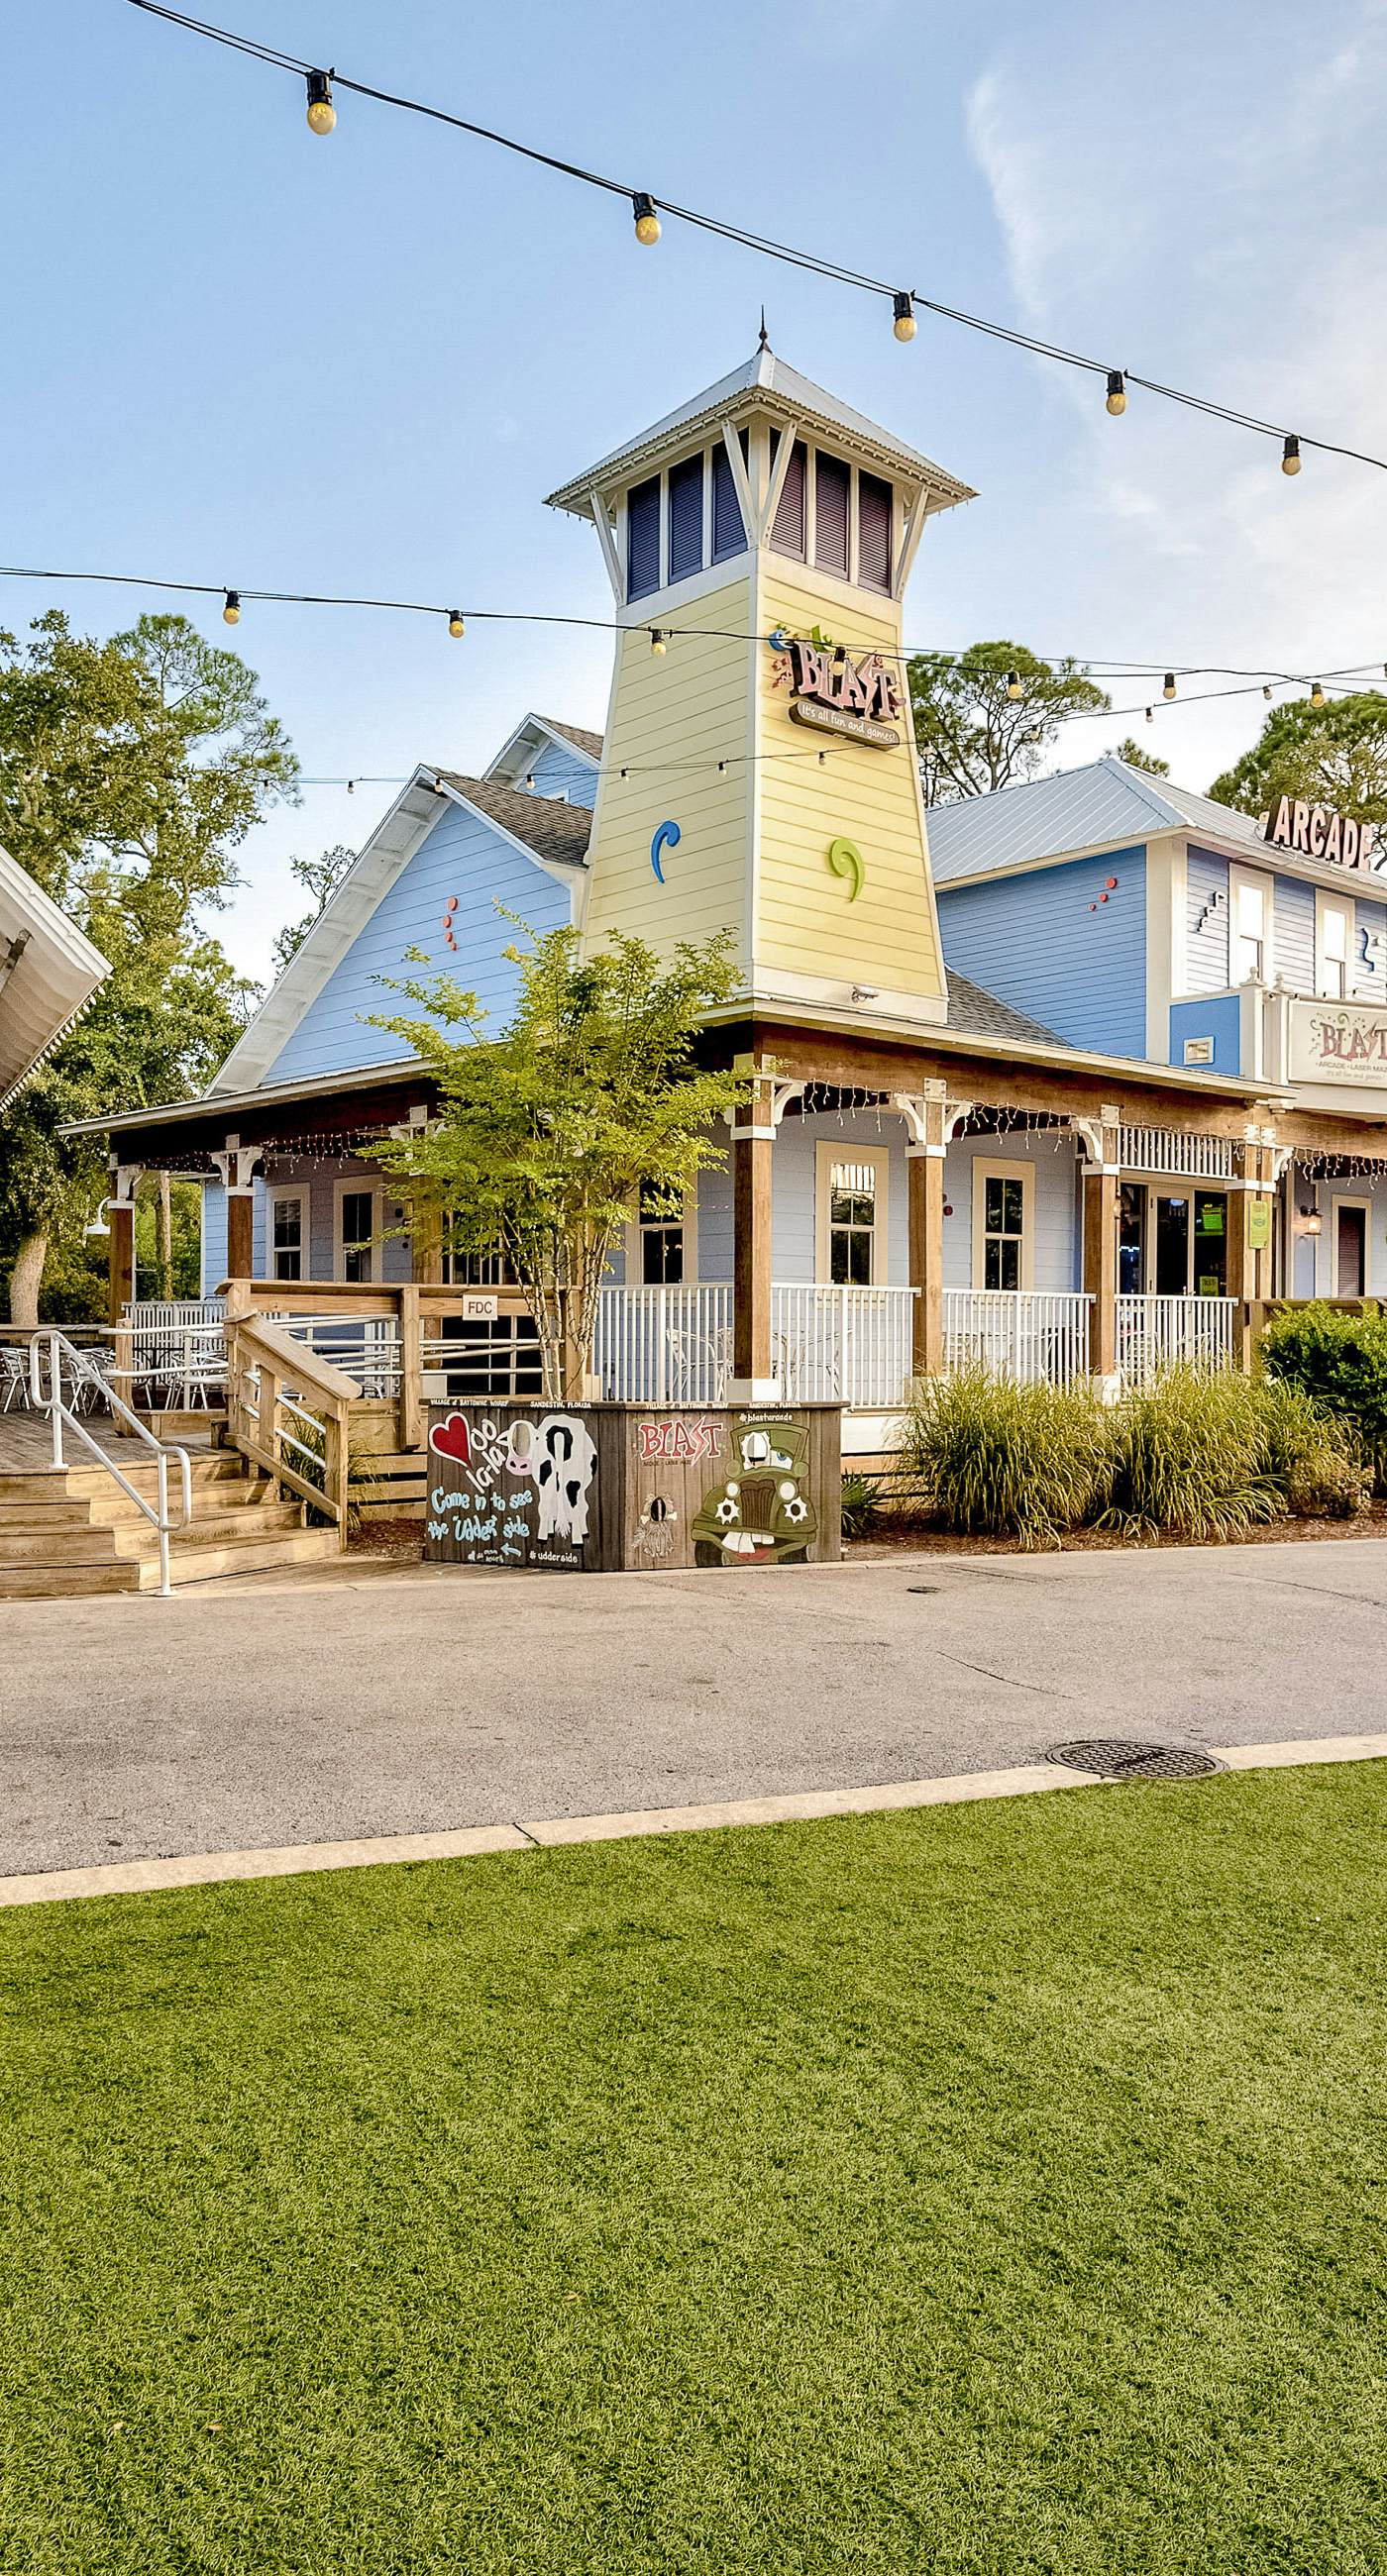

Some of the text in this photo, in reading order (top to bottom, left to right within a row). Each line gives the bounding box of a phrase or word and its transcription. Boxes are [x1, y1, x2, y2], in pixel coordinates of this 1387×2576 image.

[796, 642, 898, 722] BLAST
[801, 703, 816, 718] It's
[817, 710, 829, 722] all
[830, 713, 847, 728] fun
[848, 720, 865, 733] and
[1272, 794, 1373, 873] ARCADE
[468, 1301, 492, 1314] FDC
[640, 1415, 723, 1467] BLAST
[431, 1486, 533, 1514] Come in to see
[428, 1520, 450, 1541] the
[503, 1514, 530, 1539] side
